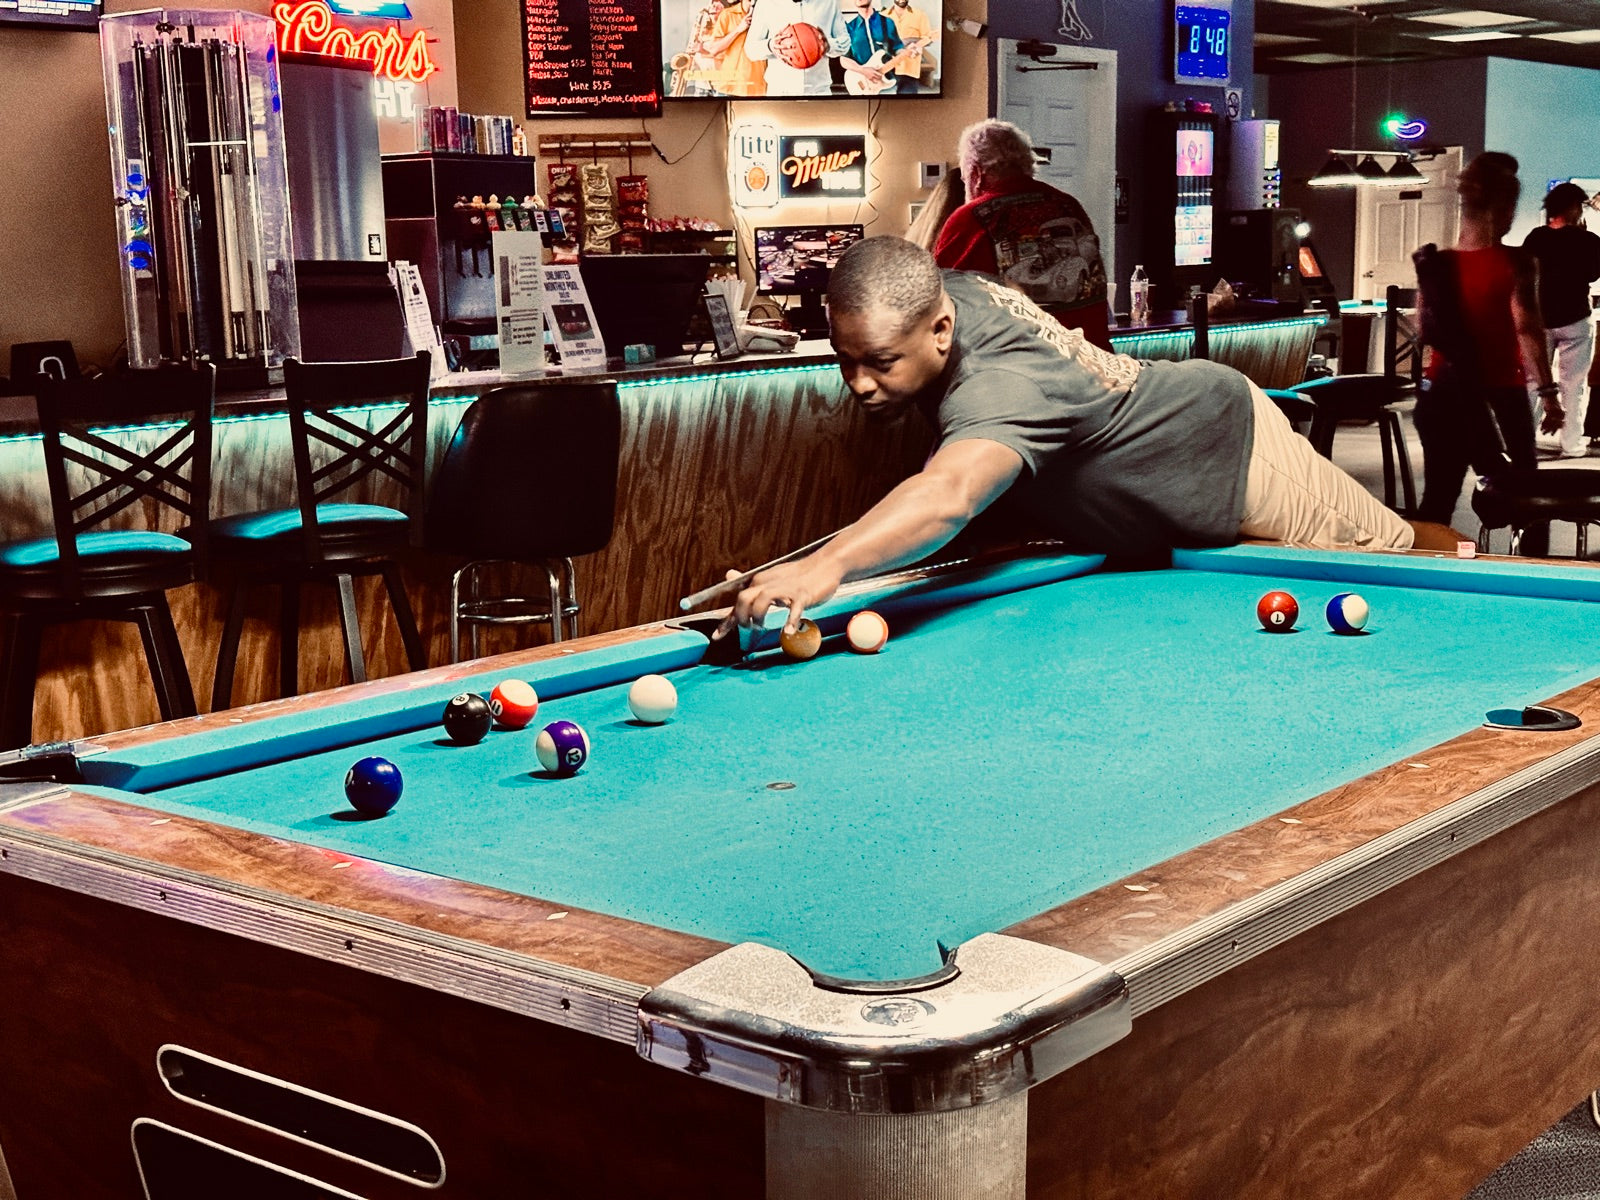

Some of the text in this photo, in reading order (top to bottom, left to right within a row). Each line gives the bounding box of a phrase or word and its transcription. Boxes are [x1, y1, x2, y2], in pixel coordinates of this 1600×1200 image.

[272, 1, 434, 82] Coors
[741, 136, 773, 159] Lite
[781, 149, 862, 188] Miller
[567, 750, 580, 764] 12
